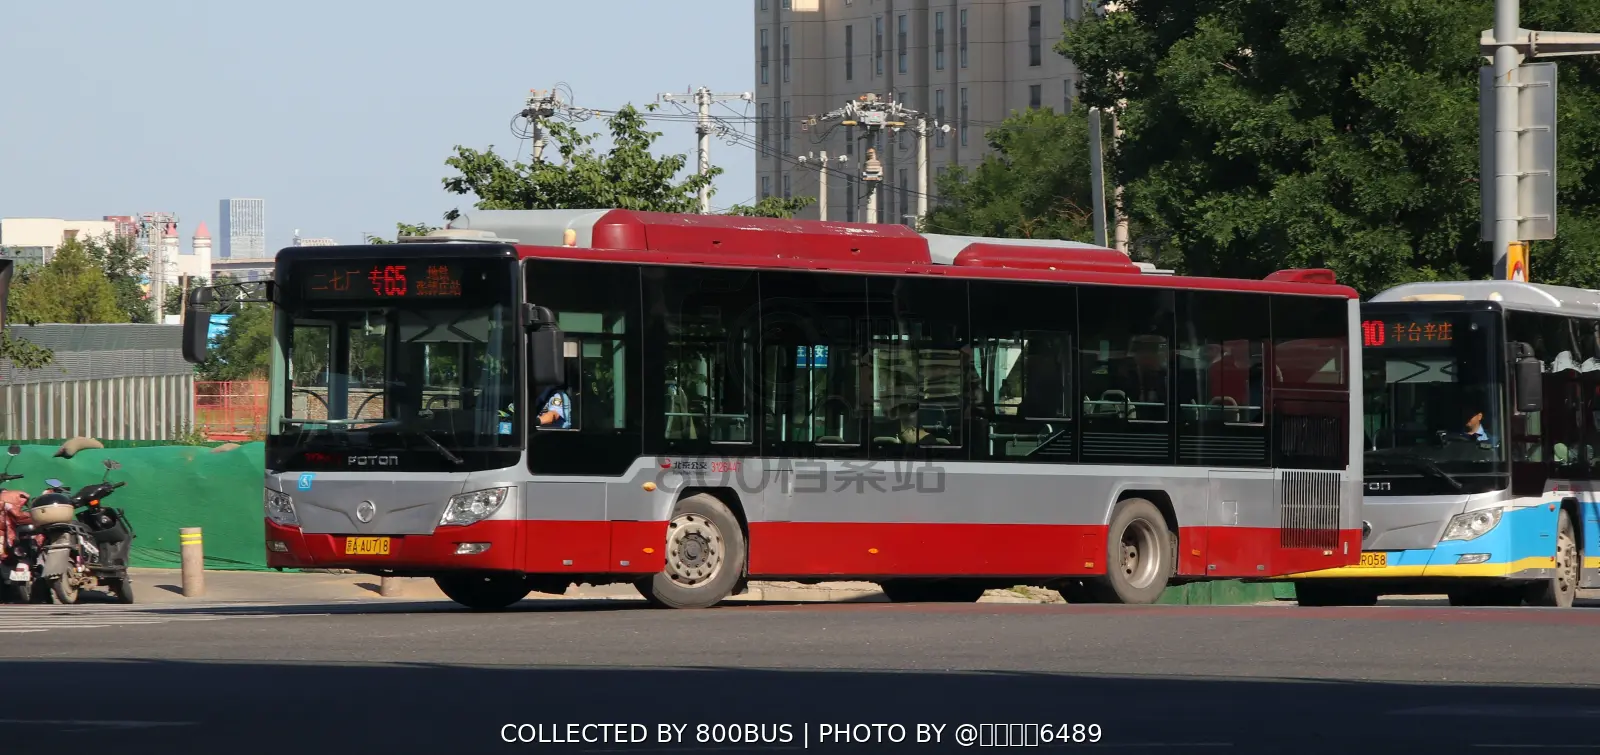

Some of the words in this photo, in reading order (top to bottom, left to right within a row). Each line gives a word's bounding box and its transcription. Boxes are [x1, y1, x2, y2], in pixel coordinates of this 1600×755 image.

[311, 269, 360, 291] 二七厂
[367, 265, 408, 296] 专65
[1391, 321, 1453, 342] 丰台辛庄
[347, 455, 399, 466] FOTON
[673, 461, 708, 470] 北京公交
